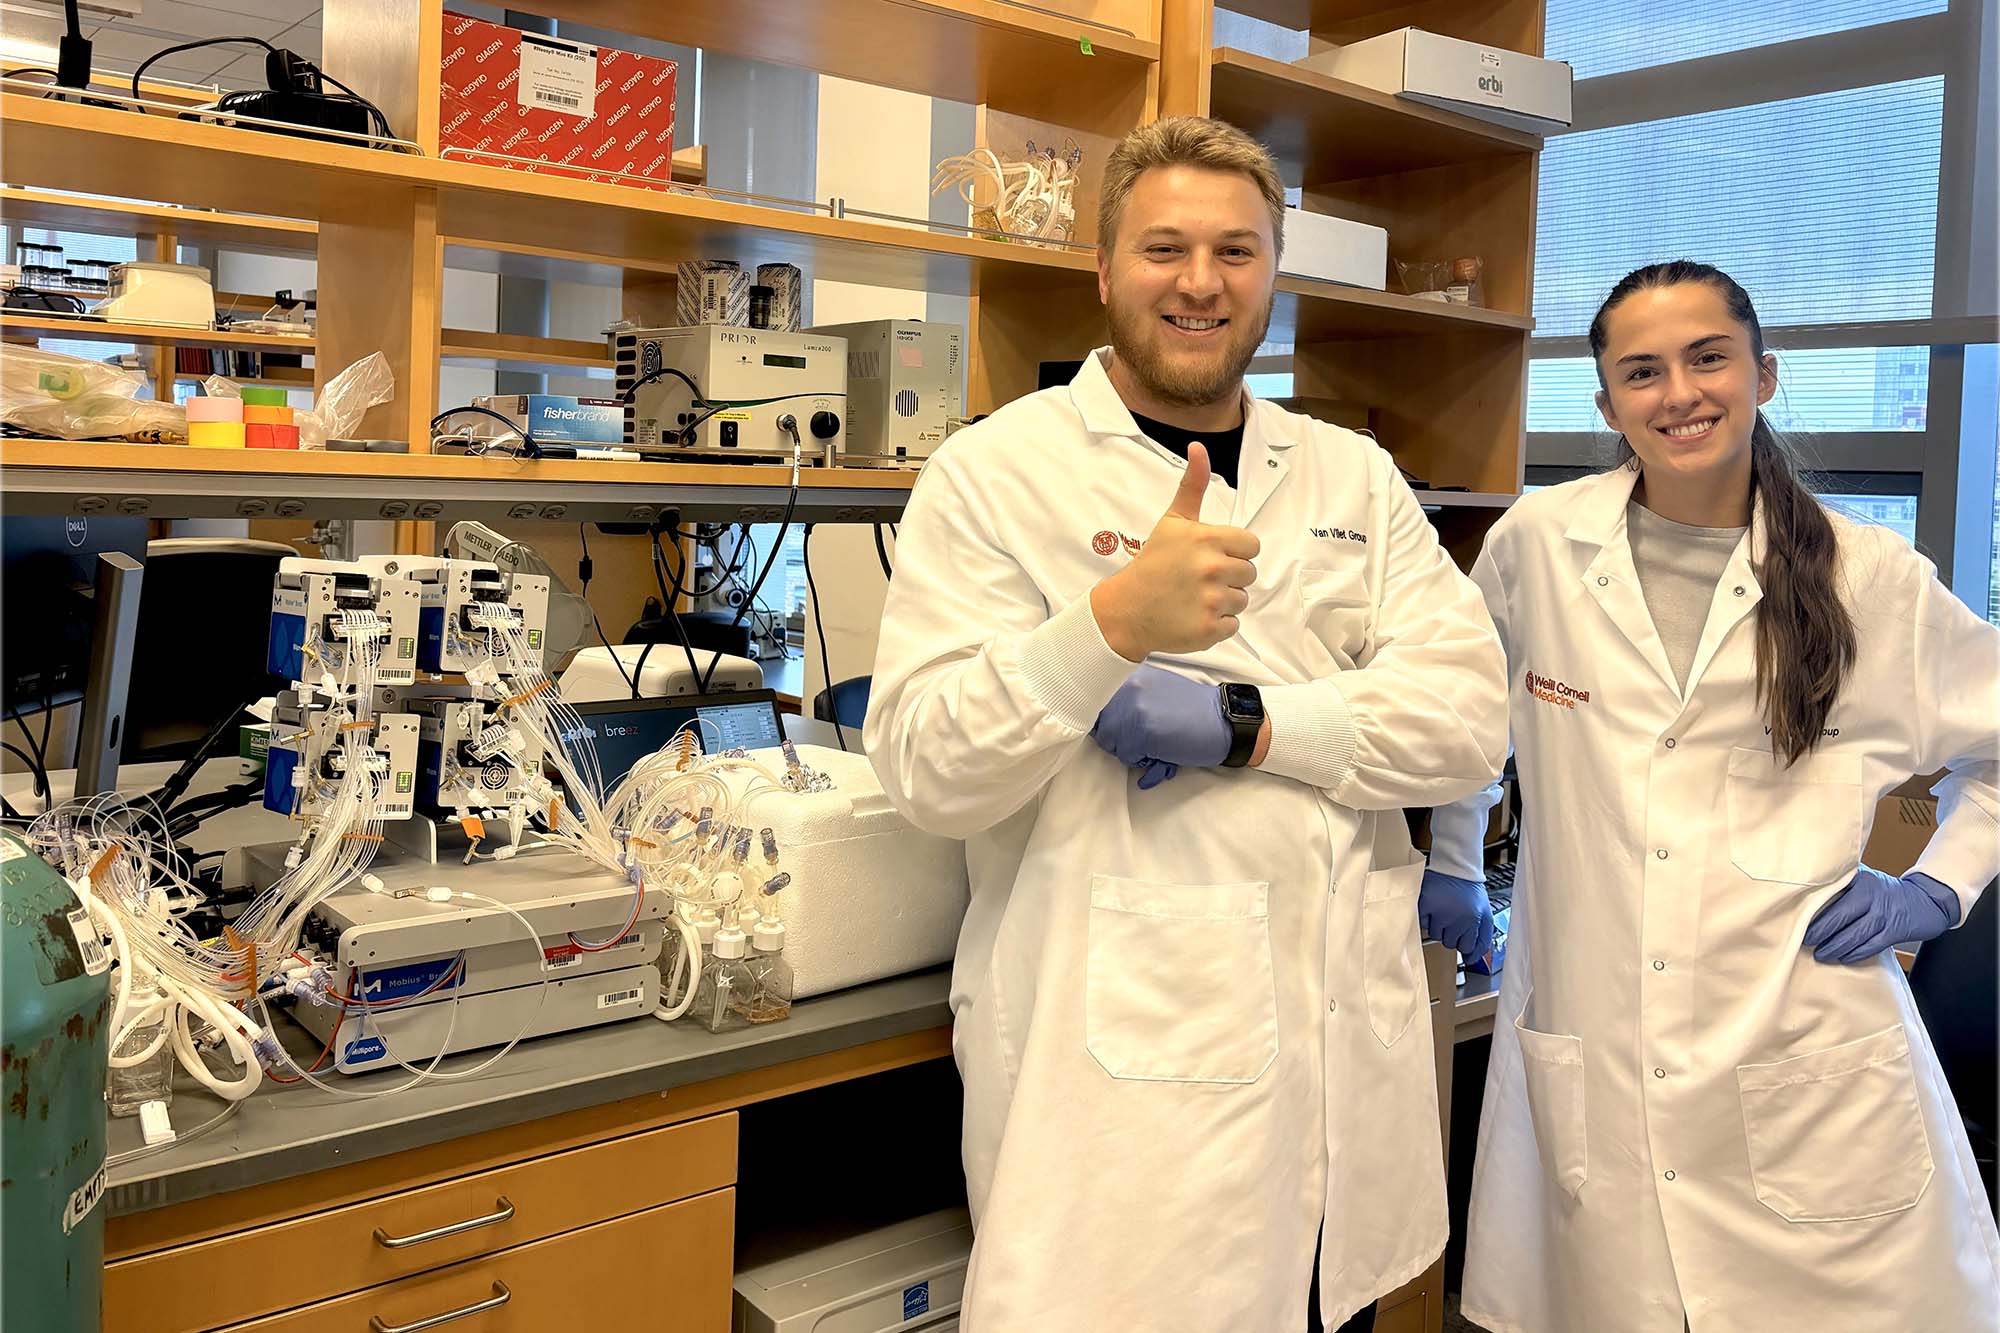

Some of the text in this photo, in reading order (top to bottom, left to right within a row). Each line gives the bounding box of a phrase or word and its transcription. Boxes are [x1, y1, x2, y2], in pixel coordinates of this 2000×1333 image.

[475, 38, 504, 63] QIAGEN
[459, 74, 488, 98] QIAGEN
[620, 70, 644, 93] QIAGEN
[652, 63, 676, 86] QIAGEN
[1478, 74, 1503, 94] erbi
[481, 101, 508, 125] QIAGEN
[606, 103, 631, 126] QIAGEN
[638, 96, 662, 119] QIAGEN
[443, 108, 472, 134] QIAGEN
[538, 118, 564, 143] QIAGEN
[502, 127, 529, 151] QIAGEN
[591, 136, 617, 160] QIAGEN
[625, 128, 649, 152] QIAGEN
[642, 153, 666, 177] QIAGEN
[543, 406, 609, 423] fisherbrand
[68, 521, 85, 532] DELL
[1309, 527, 1329, 538] Van
[1348, 529, 1367, 545] Group
[463, 530, 520, 567] METTLER TLEDO
[1534, 674, 1590, 704] Weill Cornell
[1534, 687, 1576, 710] Medicine
[604, 723, 640, 737] breez
[1821, 728, 1840, 739] oup
